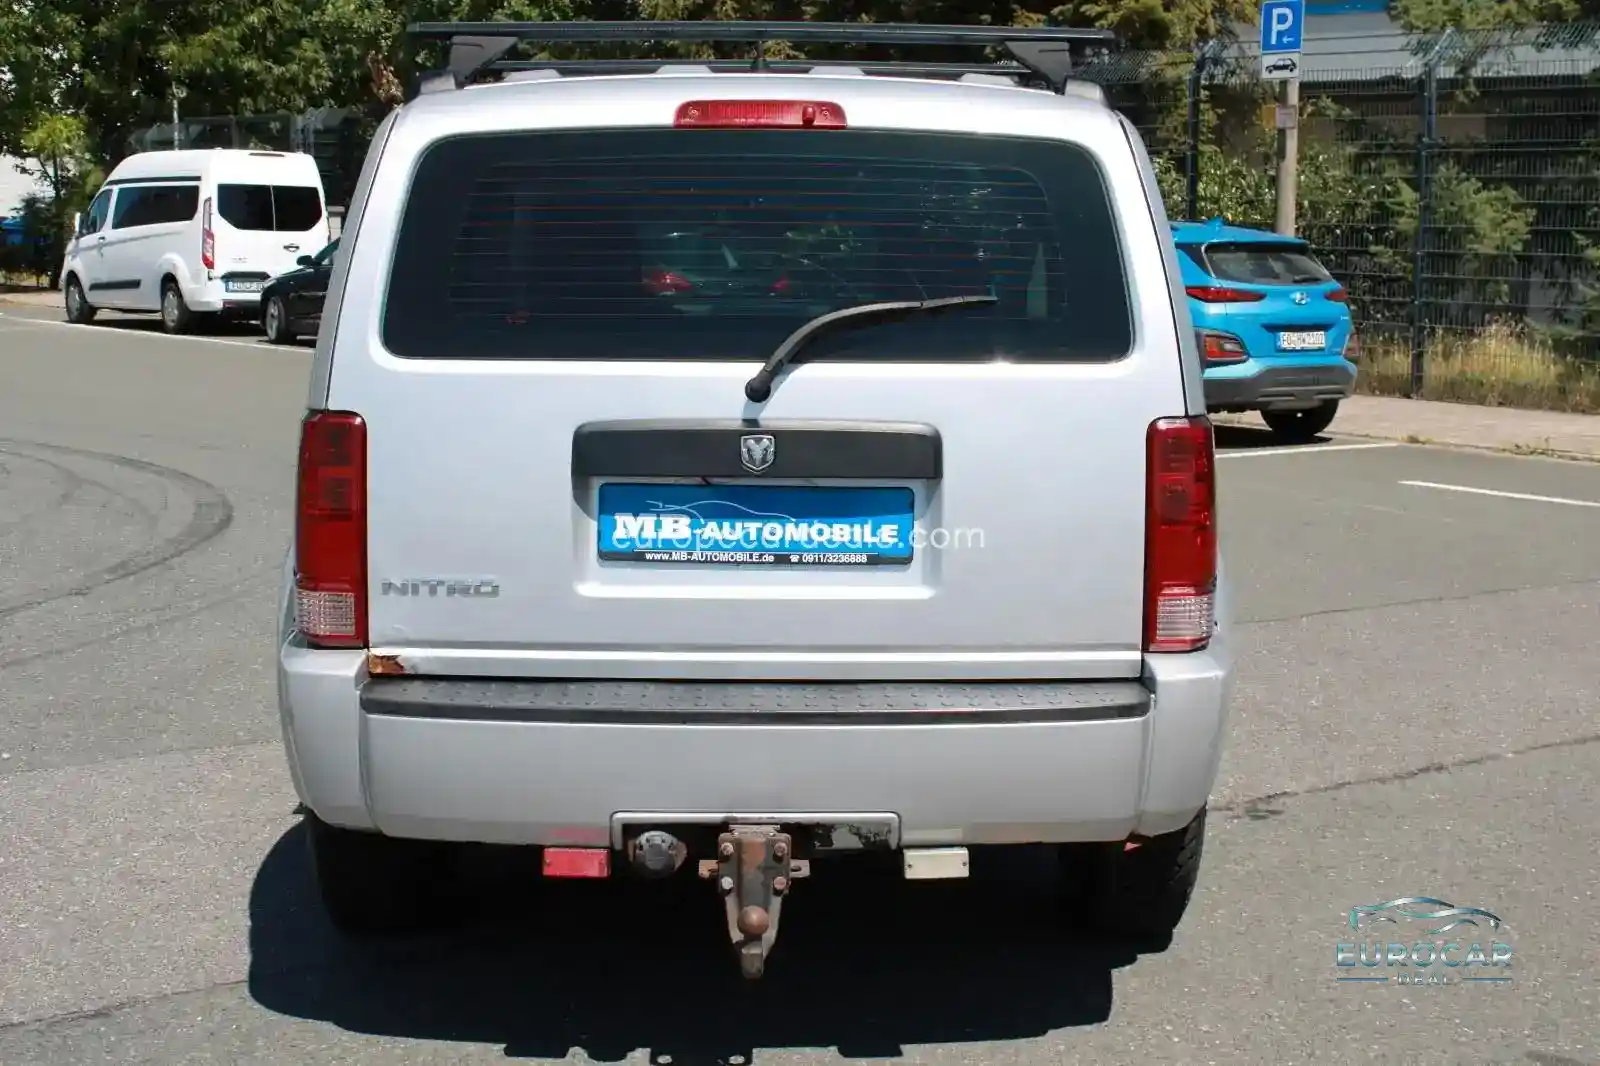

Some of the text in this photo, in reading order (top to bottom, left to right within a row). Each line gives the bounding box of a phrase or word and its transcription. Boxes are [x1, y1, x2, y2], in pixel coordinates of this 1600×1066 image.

[1271, 7, 1293, 45] P
[614, 512, 899, 543] MB-AUTOMOBILE
[645, 551, 775, 562] www.MB-AUTOMOBILE.de
[381, 579, 500, 599] NITRO
